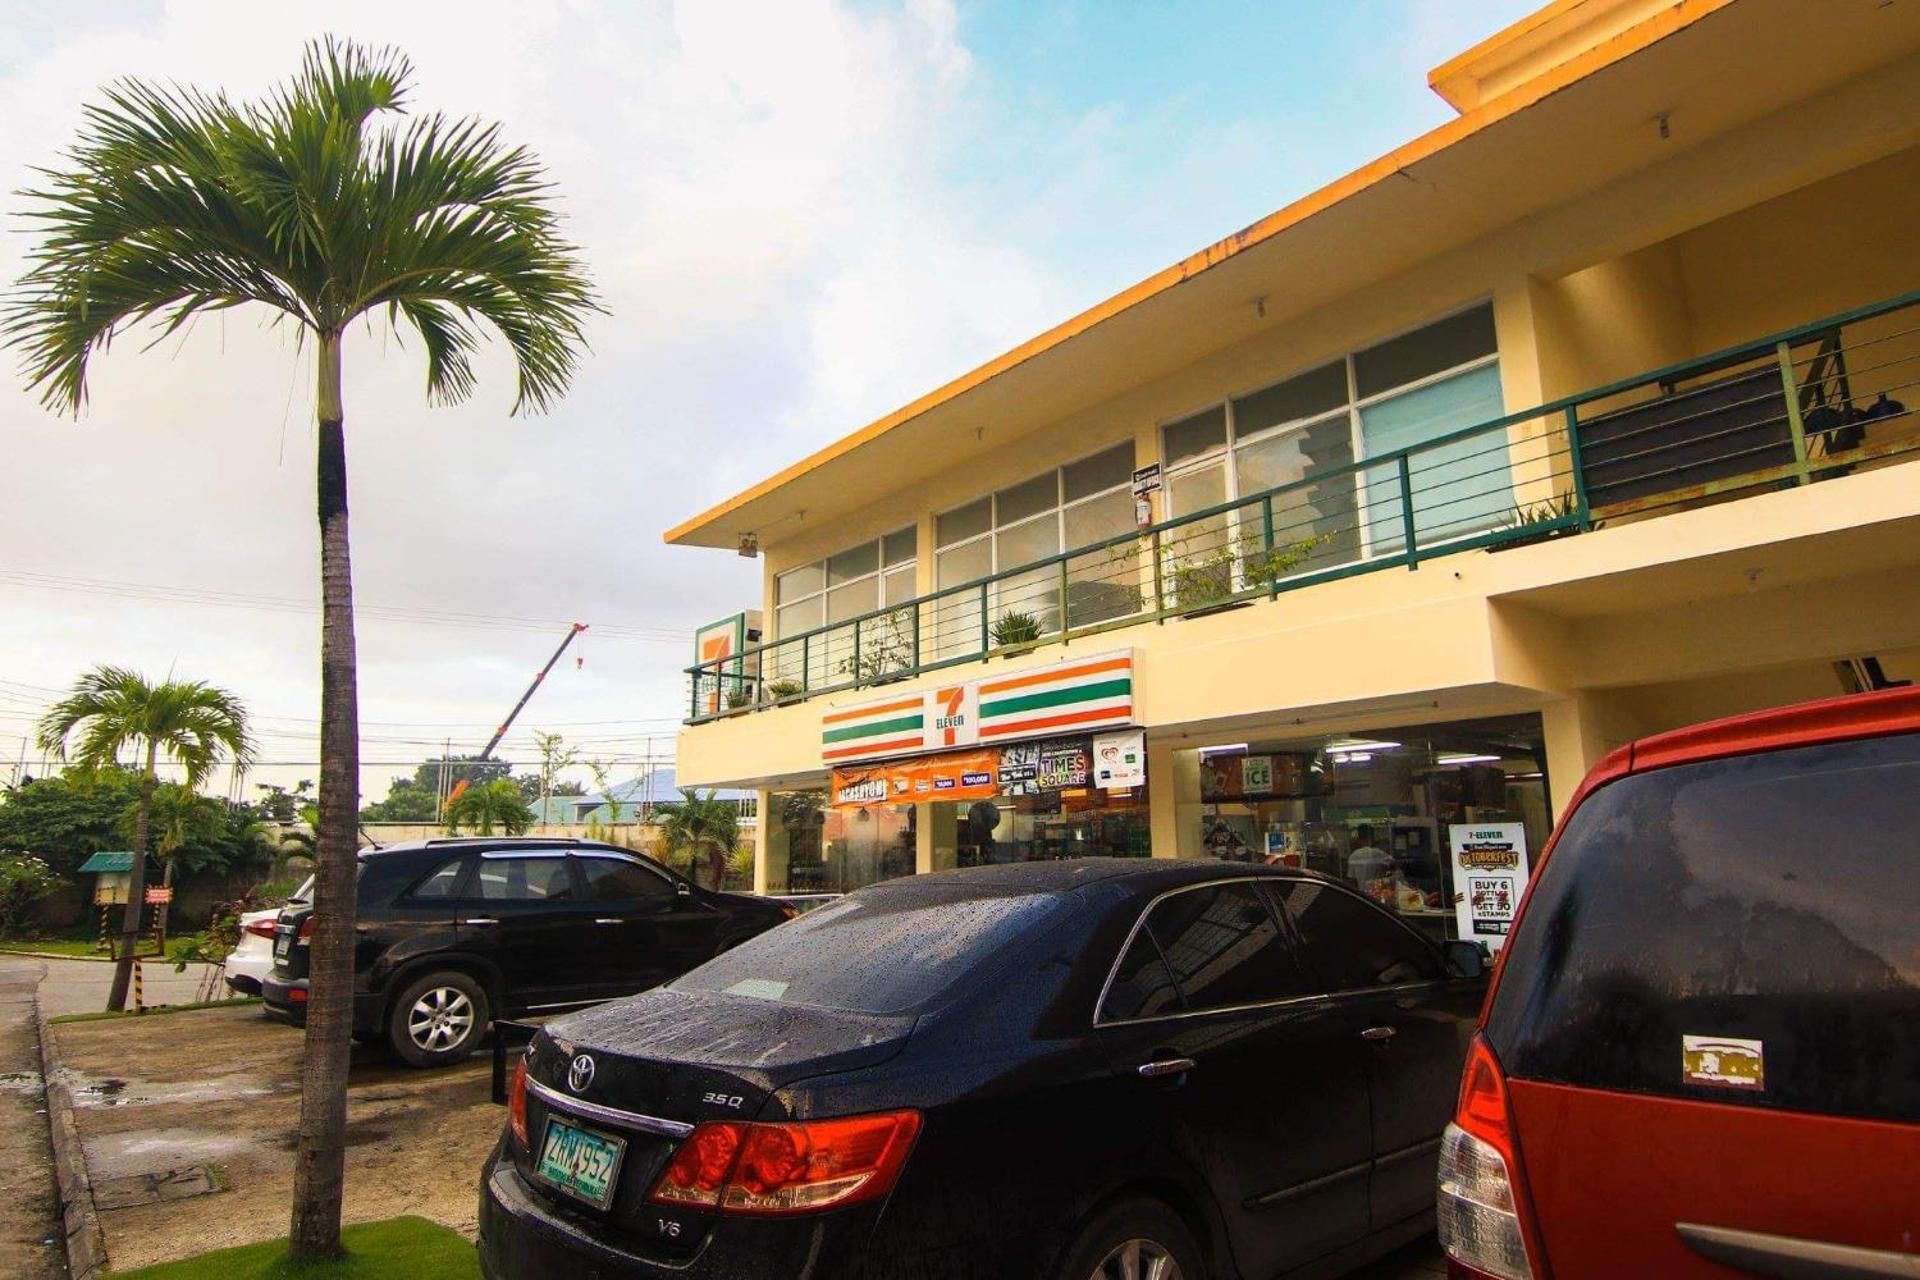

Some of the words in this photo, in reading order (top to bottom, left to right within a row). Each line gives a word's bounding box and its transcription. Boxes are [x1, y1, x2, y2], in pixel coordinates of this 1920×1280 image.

[936, 686, 964, 745] 7
[1040, 755, 1085, 774] TIMES
[1040, 772, 1086, 787] SQUARE
[1475, 881, 1497, 890] BUY
[1501, 881, 1508, 890] 6
[1476, 903, 1495, 911] GET
[1497, 902, 1511, 911] 50
[658, 1218, 681, 1237] V6
